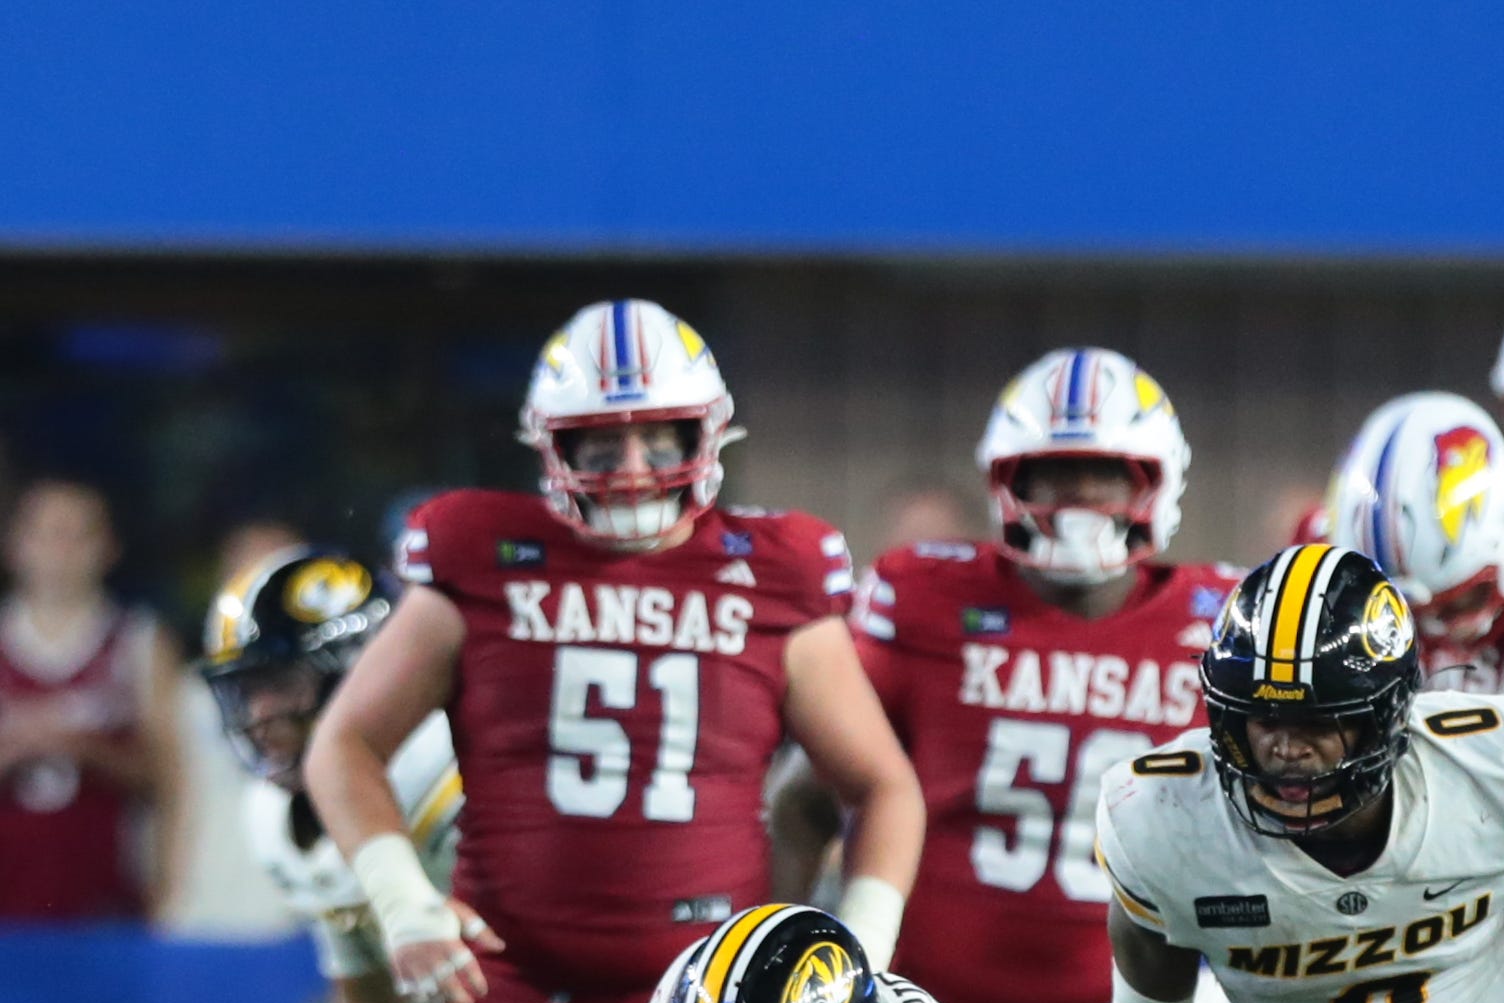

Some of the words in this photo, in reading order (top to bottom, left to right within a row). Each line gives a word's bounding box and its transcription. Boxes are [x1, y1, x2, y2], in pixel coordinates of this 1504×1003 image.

[504, 580, 755, 656] KANSAS
[959, 643, 1202, 727] KANSAS
[1252, 683, 1306, 700] Missouri
[1425, 707, 1500, 739] 0
[546, 645, 701, 823] 51
[1131, 750, 1203, 777] 0
[1228, 892, 1492, 979] MIZZOU
